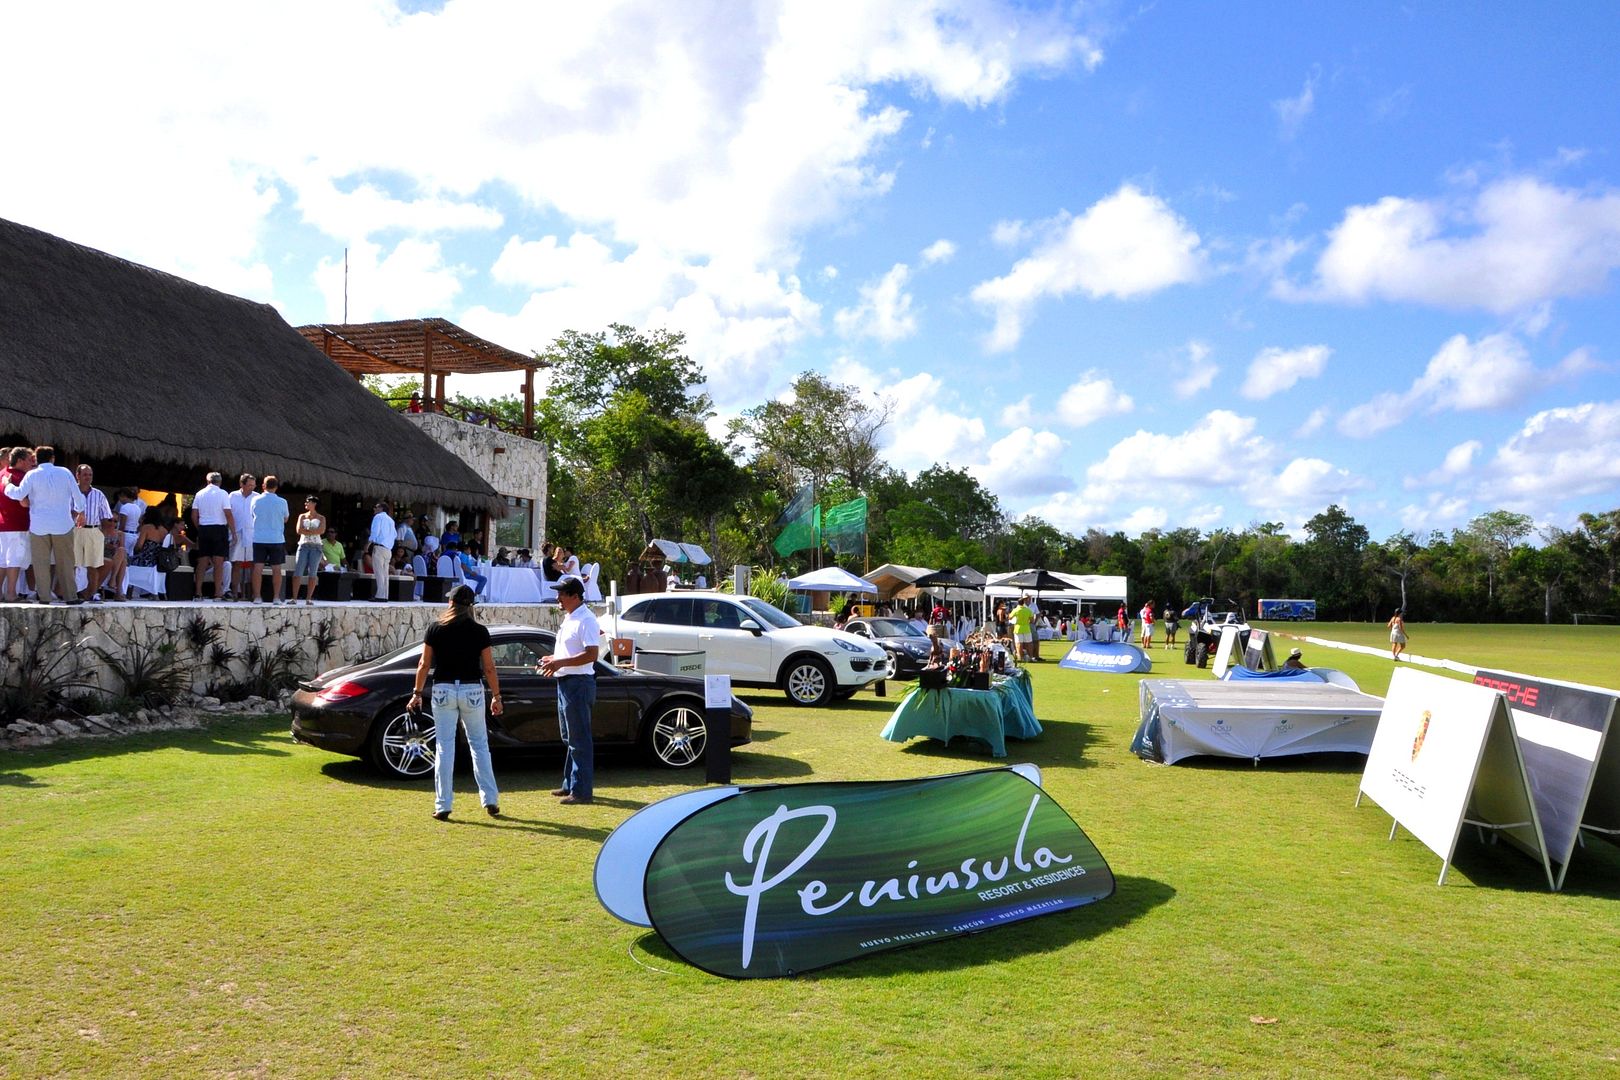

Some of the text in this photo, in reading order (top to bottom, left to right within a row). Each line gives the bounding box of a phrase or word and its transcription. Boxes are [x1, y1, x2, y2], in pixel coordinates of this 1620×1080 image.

[725, 794, 1073, 969] Peninsula
[977, 866, 1086, 901] RESORT & RESIDENCES
[860, 898, 1064, 948] NUEVO VALLARTA CANCÚN NUEVO MAZATLÁN
